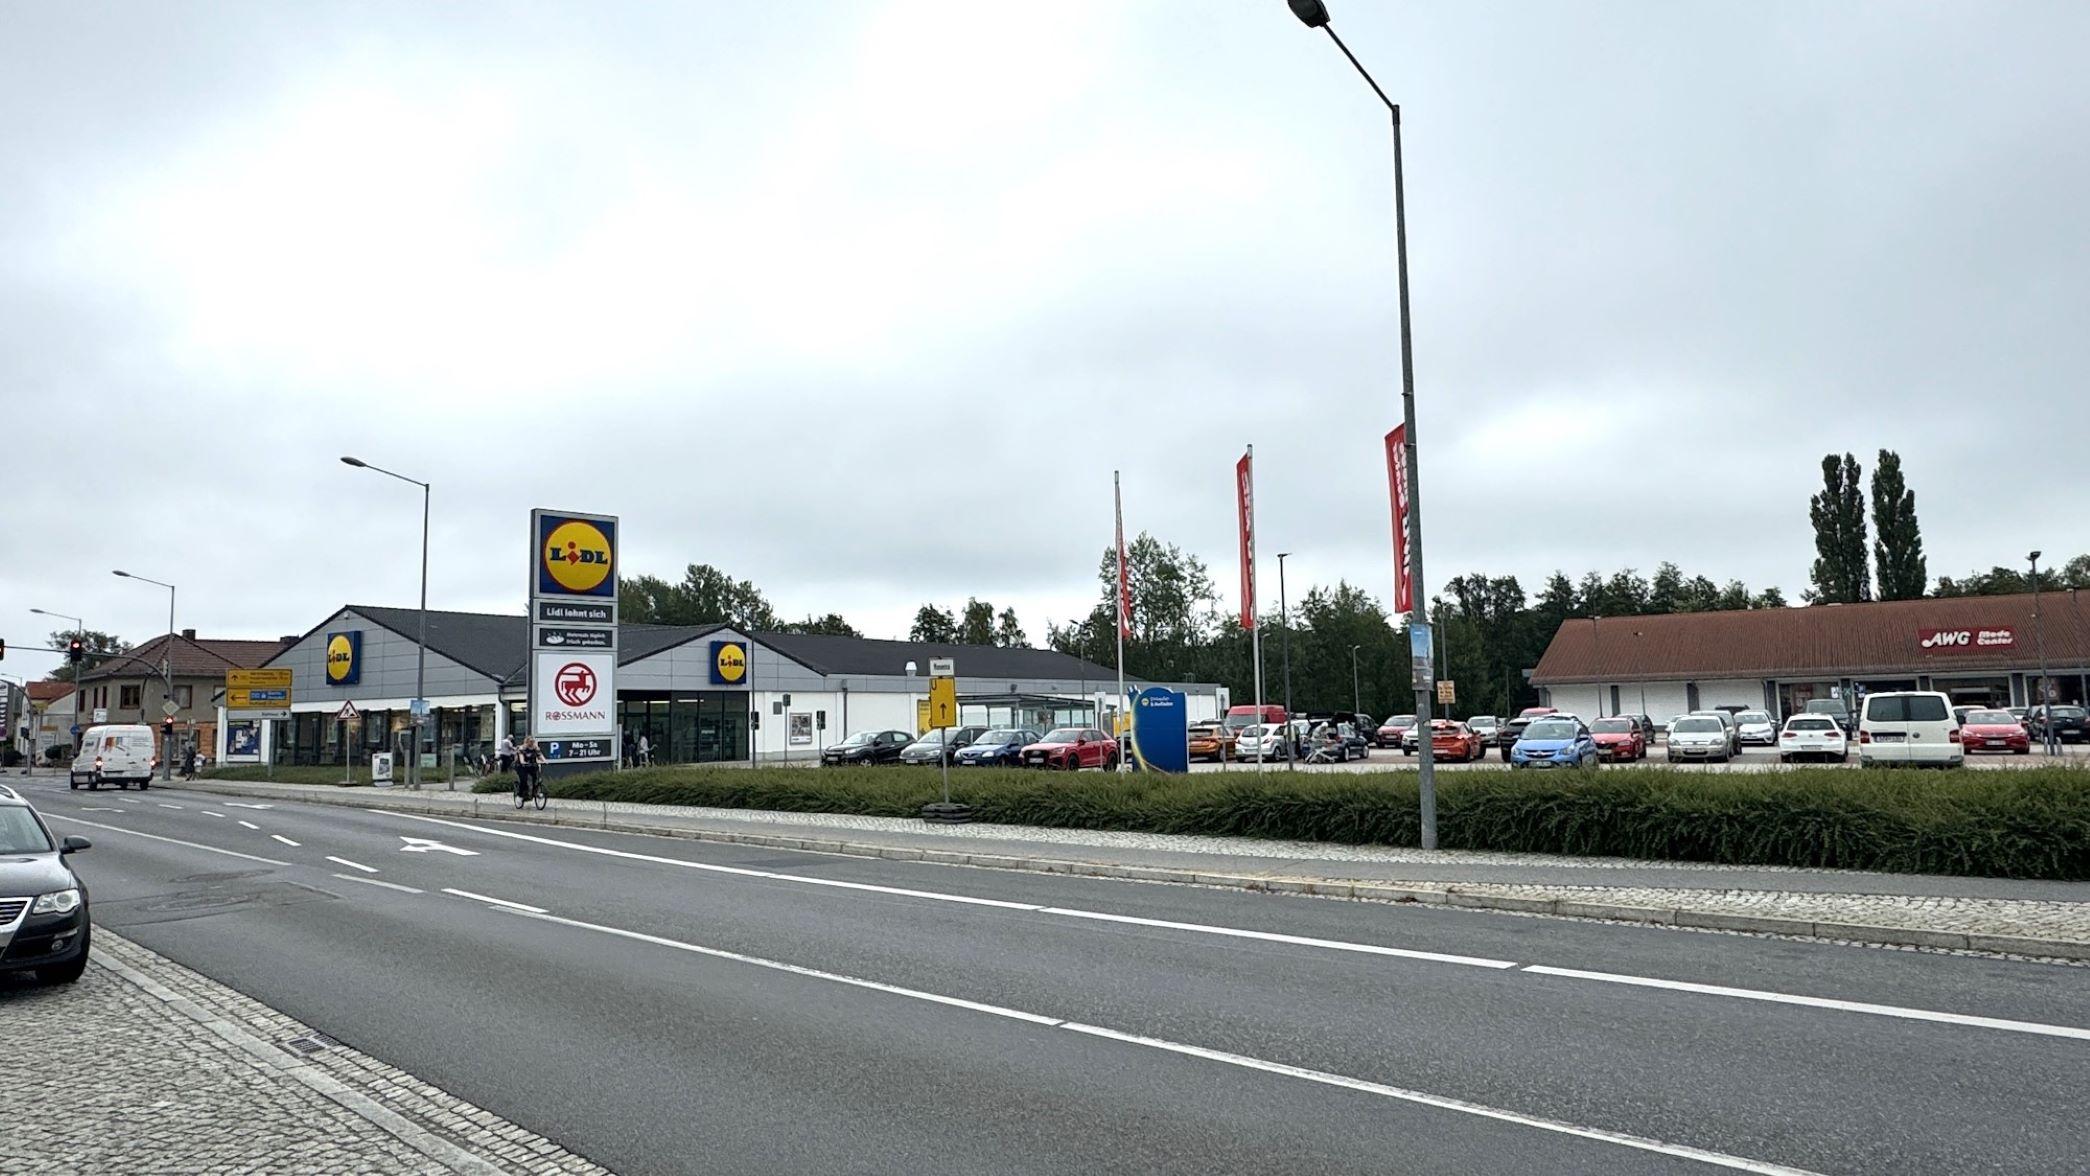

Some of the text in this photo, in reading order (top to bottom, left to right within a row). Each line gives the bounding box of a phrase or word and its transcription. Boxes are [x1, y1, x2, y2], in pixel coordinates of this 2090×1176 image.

[546, 607, 607, 619] Lidl lohnt sich
[1921, 629, 2011, 648] AWG Mode
[1977, 637, 2013, 646] Center
[545, 711, 606, 721] ROSSMANN
